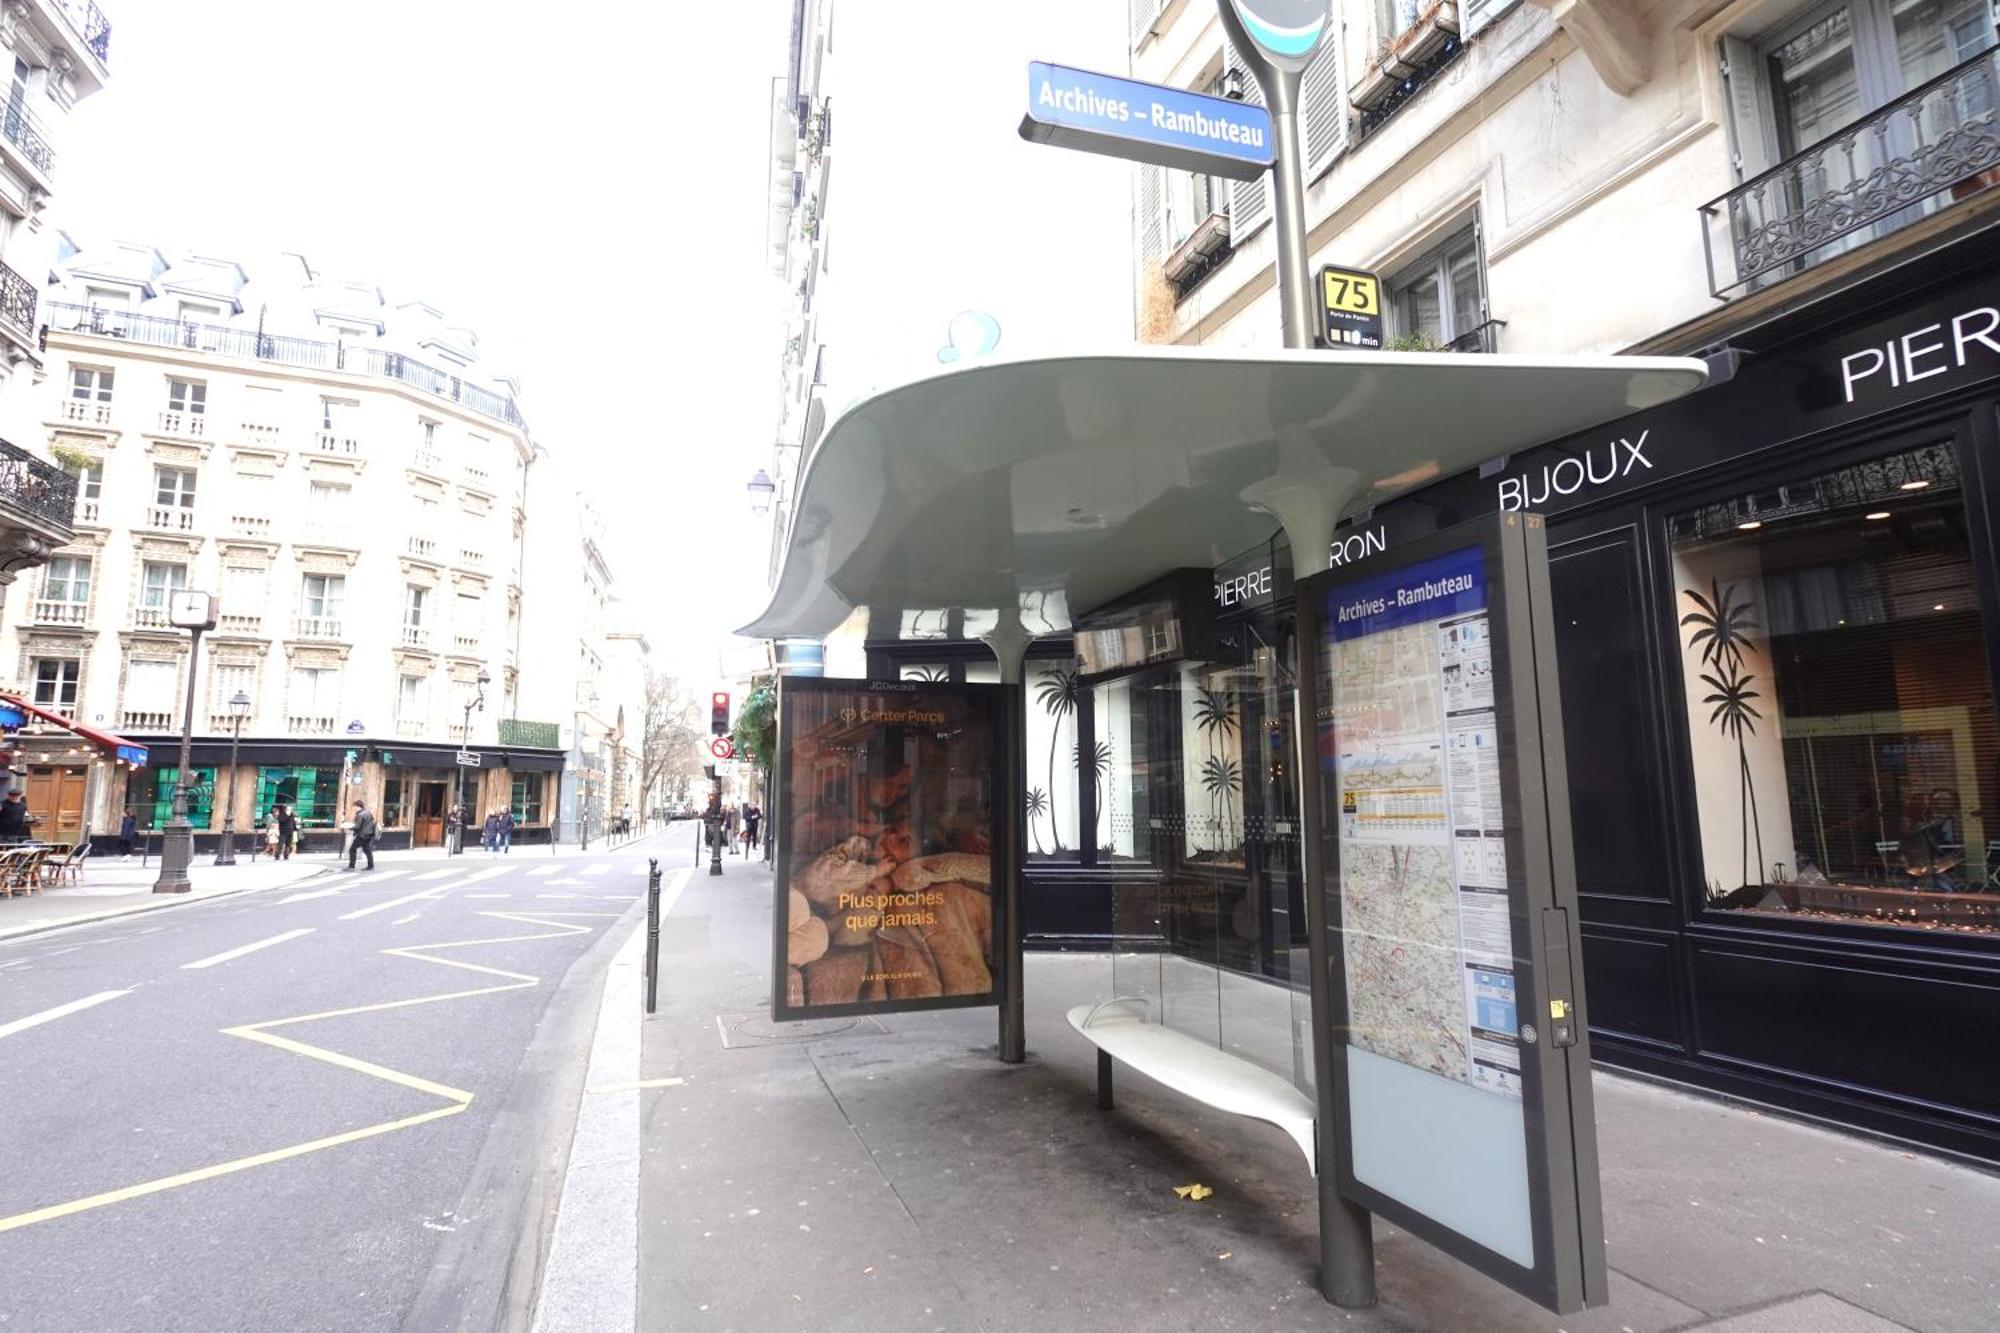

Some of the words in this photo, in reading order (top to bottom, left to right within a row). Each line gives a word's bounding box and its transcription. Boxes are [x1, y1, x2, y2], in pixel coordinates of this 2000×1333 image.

[1039, 80, 1129, 122] Archives
[1151, 102, 1264, 148] Rambuteau
[1331, 276, 1369, 310] 75
[1362, 336, 1378, 347] min
[1840, 306, 2000, 402] PIER
[1497, 429, 1653, 512] BIJOUX
[1330, 525, 1386, 569] RON
[1338, 598, 1385, 623] Archives
[1397, 573, 1473, 608] Rambuteau
[1344, 792, 1355, 805] 75
[839, 893, 875, 909] Plus
[878, 889, 944, 911] proches
[845, 914, 878, 932] que
[879, 910, 938, 931] jamais.
